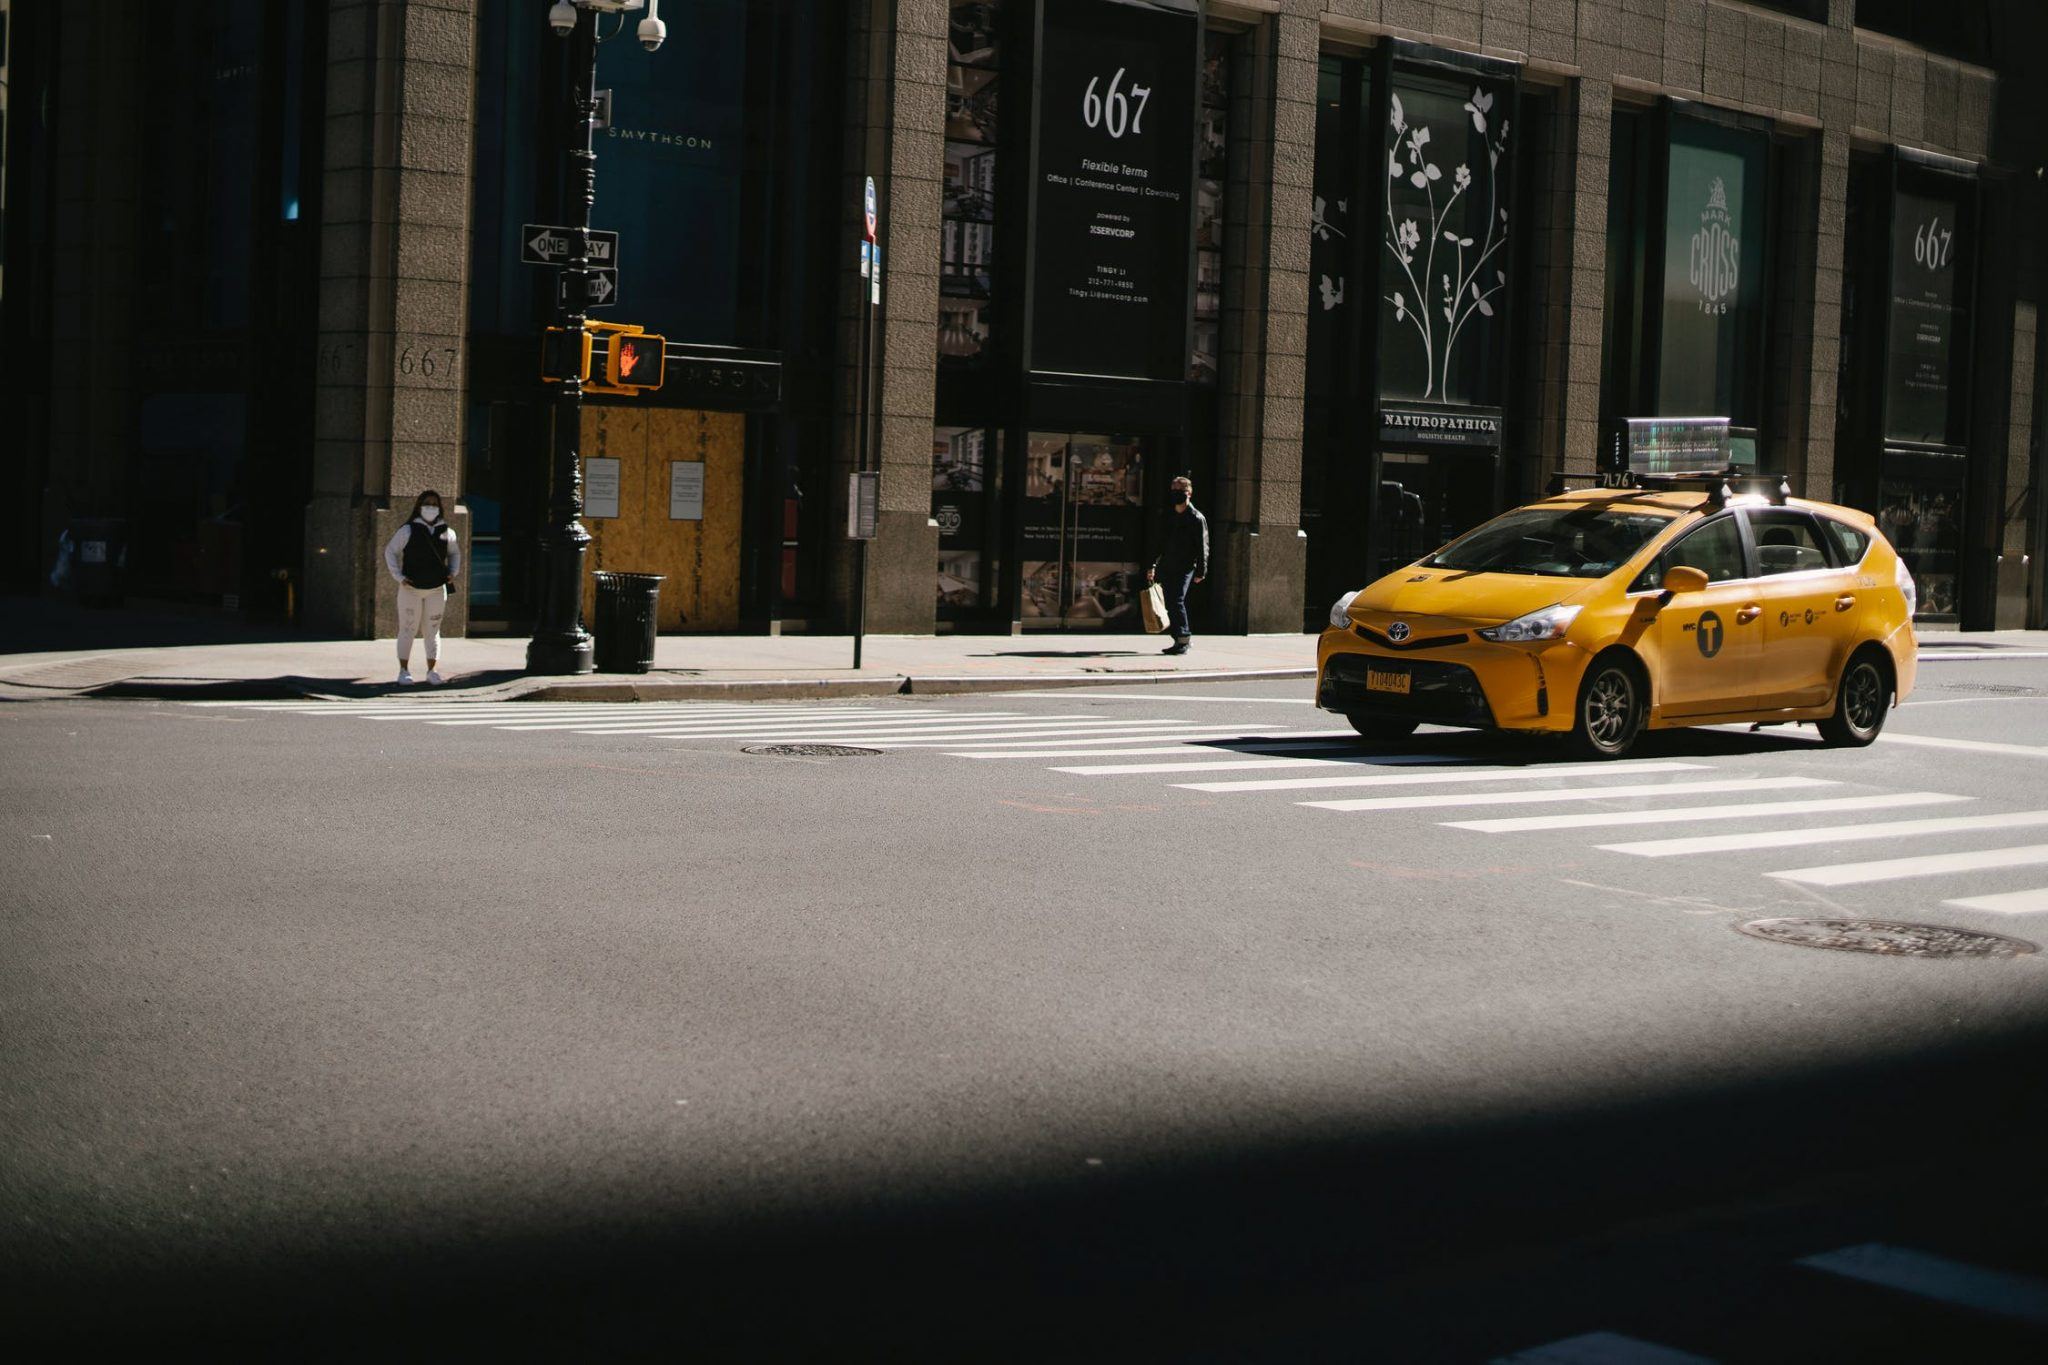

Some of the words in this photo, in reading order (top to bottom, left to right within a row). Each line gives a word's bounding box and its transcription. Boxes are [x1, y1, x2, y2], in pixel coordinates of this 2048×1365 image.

[1083, 67, 1151, 138] 667
[609, 127, 712, 149] SMYTHSON
[1082, 158, 1119, 174] Flexible
[1121, 164, 1149, 178] Terms
[1047, 174, 1068, 184] Office
[1075, 178, 1115, 191] Conference
[1116, 184, 1138, 194] Center
[1145, 188, 1180, 201] Coworking
[1701, 209, 1732, 227] MARK
[538, 239, 564, 253] ONE
[1914, 217, 1952, 270] 667
[1690, 222, 1738, 301] CROSS
[1698, 299, 1727, 316] 1845
[400, 346, 457, 377] 667
[1385, 414, 1497, 431] NATUROPATHICA
[1417, 433, 1443, 441] HOLISTIC
[1444, 433, 1466, 441] HEALTH
[1602, 472, 1629, 488] 7L76
[1702, 620, 1717, 652] T
